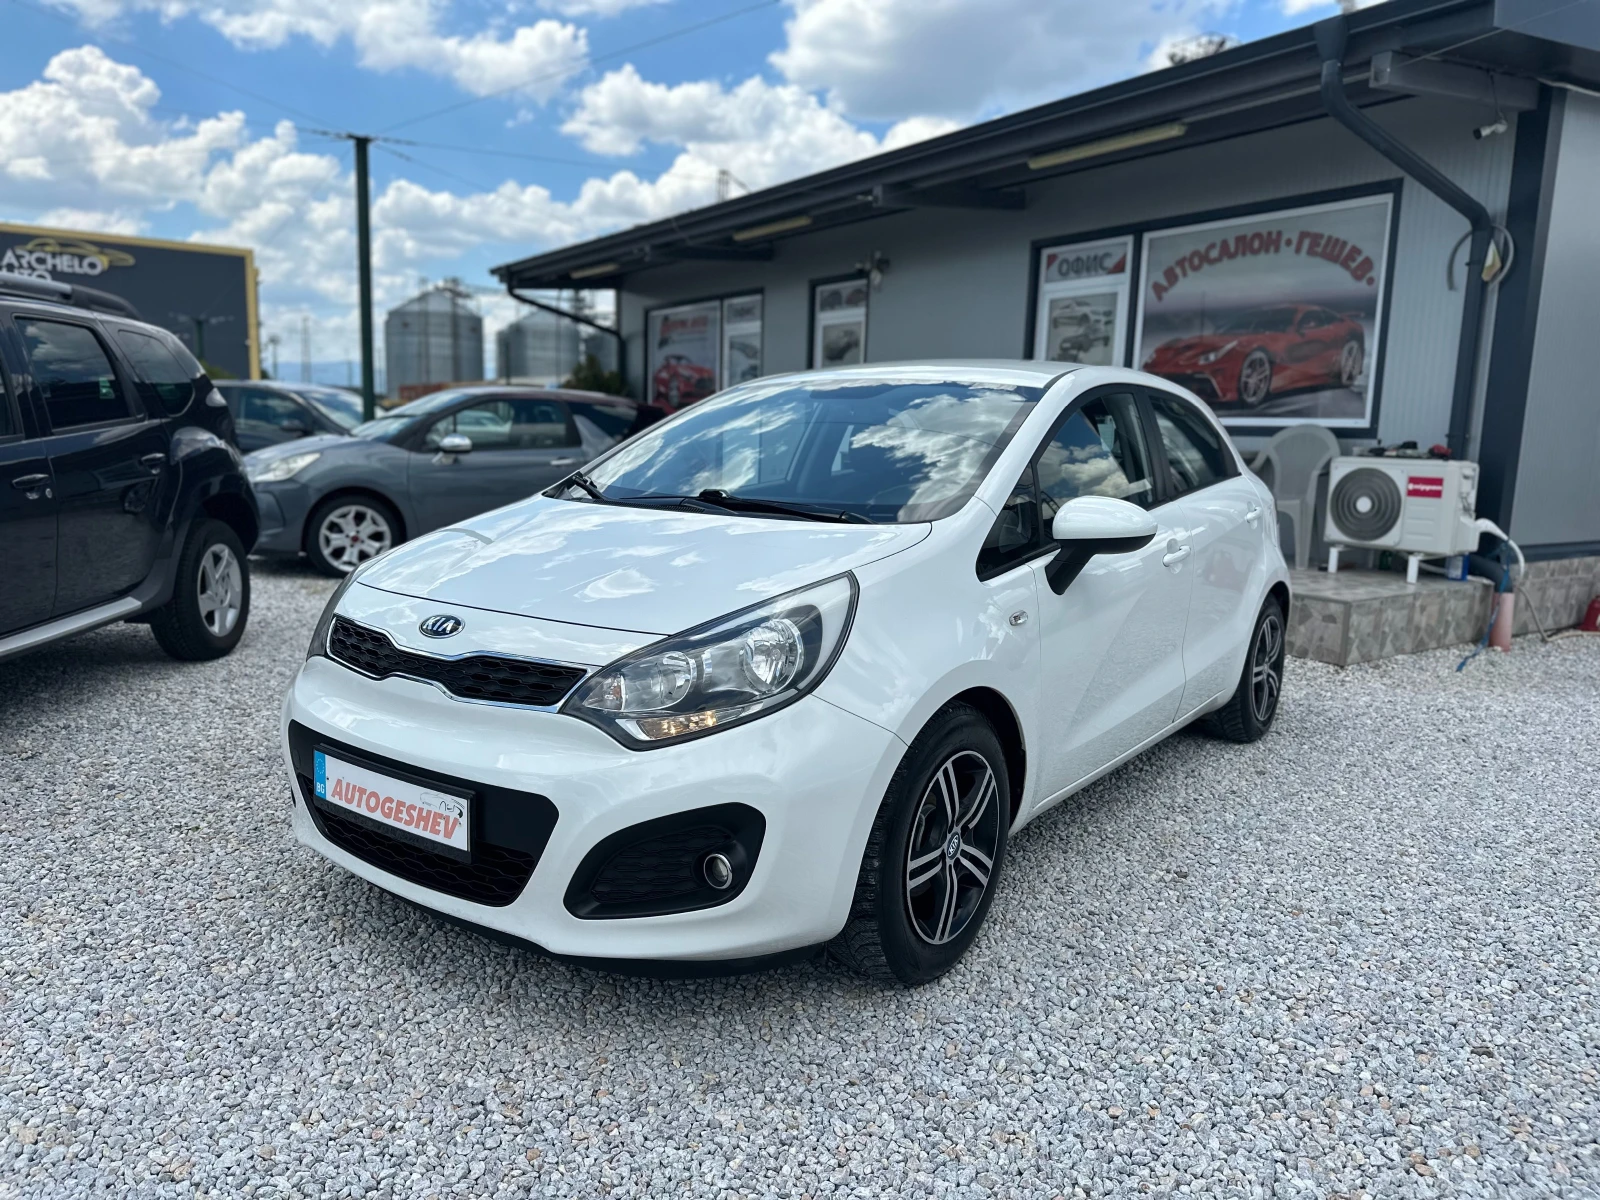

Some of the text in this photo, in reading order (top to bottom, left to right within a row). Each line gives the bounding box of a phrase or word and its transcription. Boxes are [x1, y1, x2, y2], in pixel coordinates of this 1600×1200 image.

[1, 248, 103, 276] ARCHELO
[1058, 252, 1112, 276] ОФИС
[1152, 230, 1374, 302] АВТОСАЛОН ГЕШЕВ
[422, 616, 455, 634] KIA
[316, 781, 325, 794] BG
[331, 778, 460, 839] AUTOGESHEV
